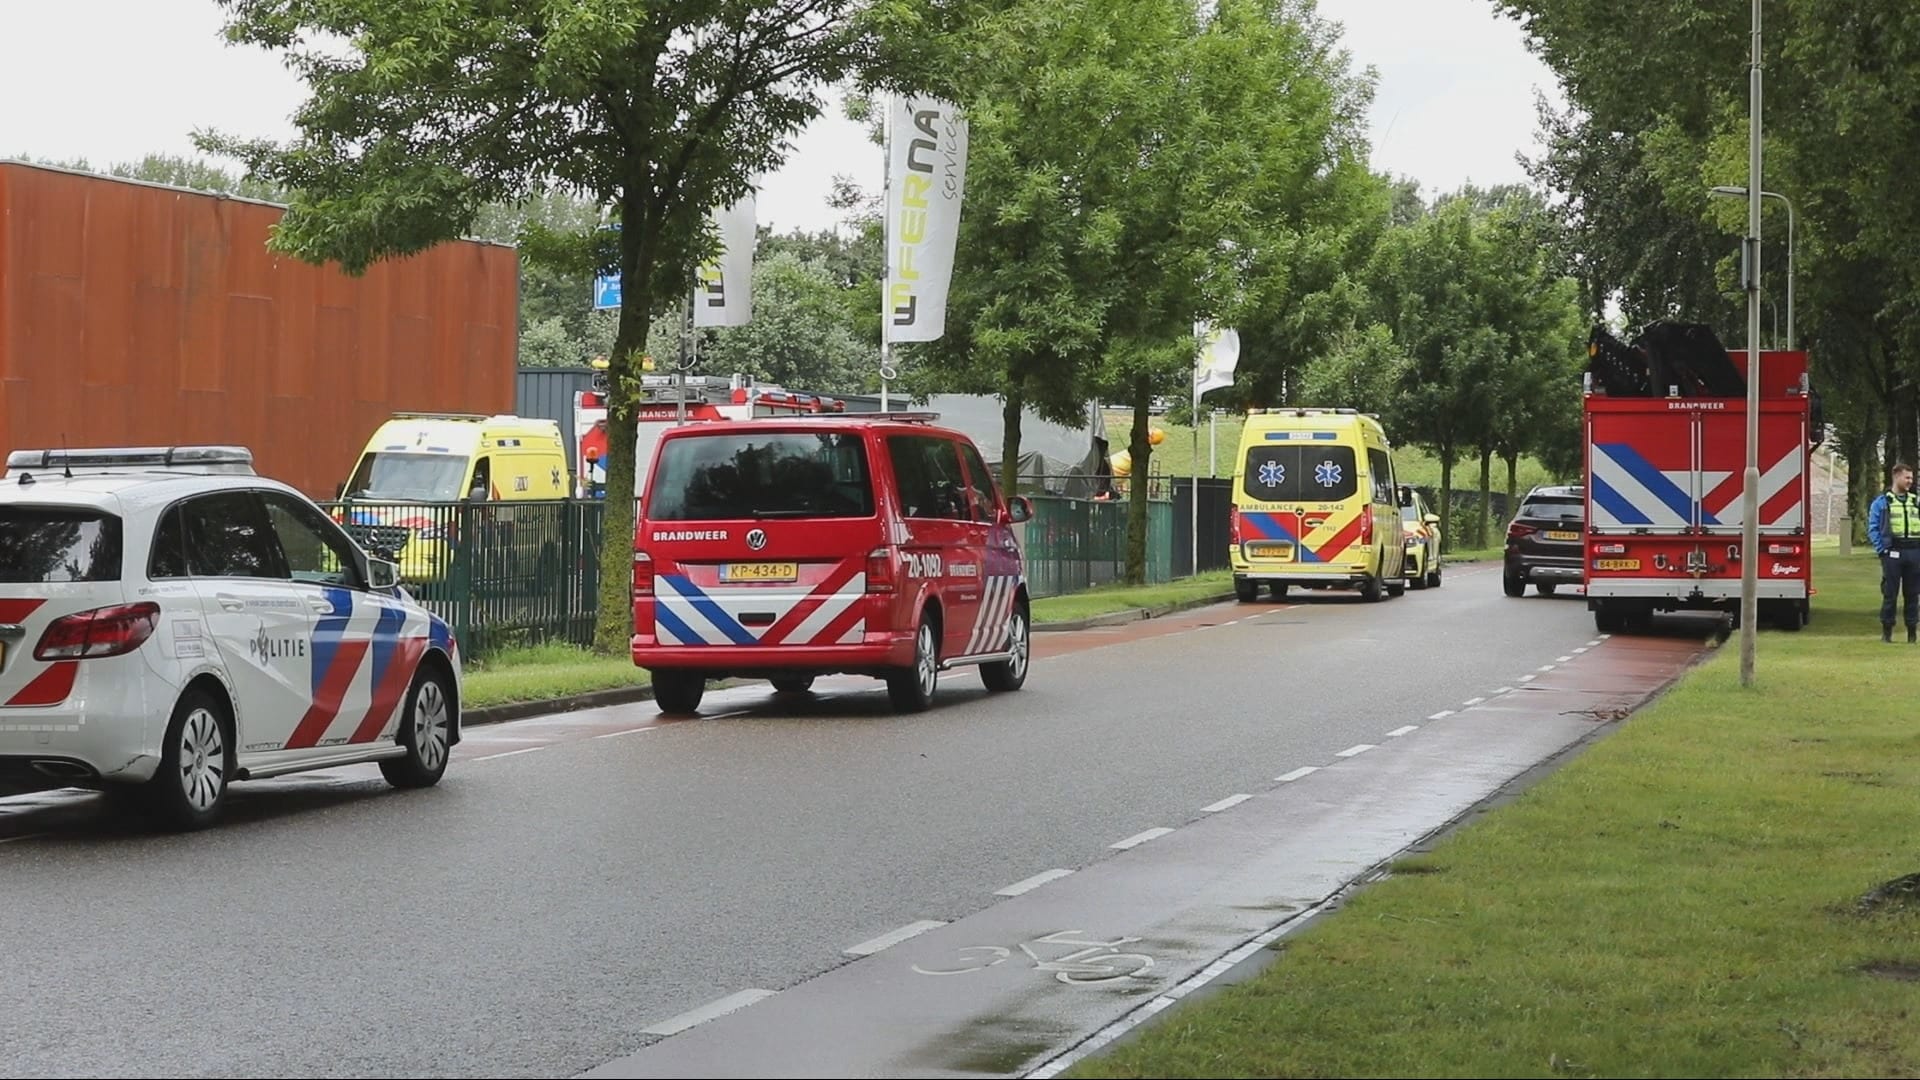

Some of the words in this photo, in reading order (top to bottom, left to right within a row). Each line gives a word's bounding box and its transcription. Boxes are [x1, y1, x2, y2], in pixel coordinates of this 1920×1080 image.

[1668, 402, 1725, 410] BRANDWEER
[652, 531, 728, 541] BRANDWEER
[730, 564, 793, 577] KP-434-D
[908, 553, 943, 578] 20-1092
